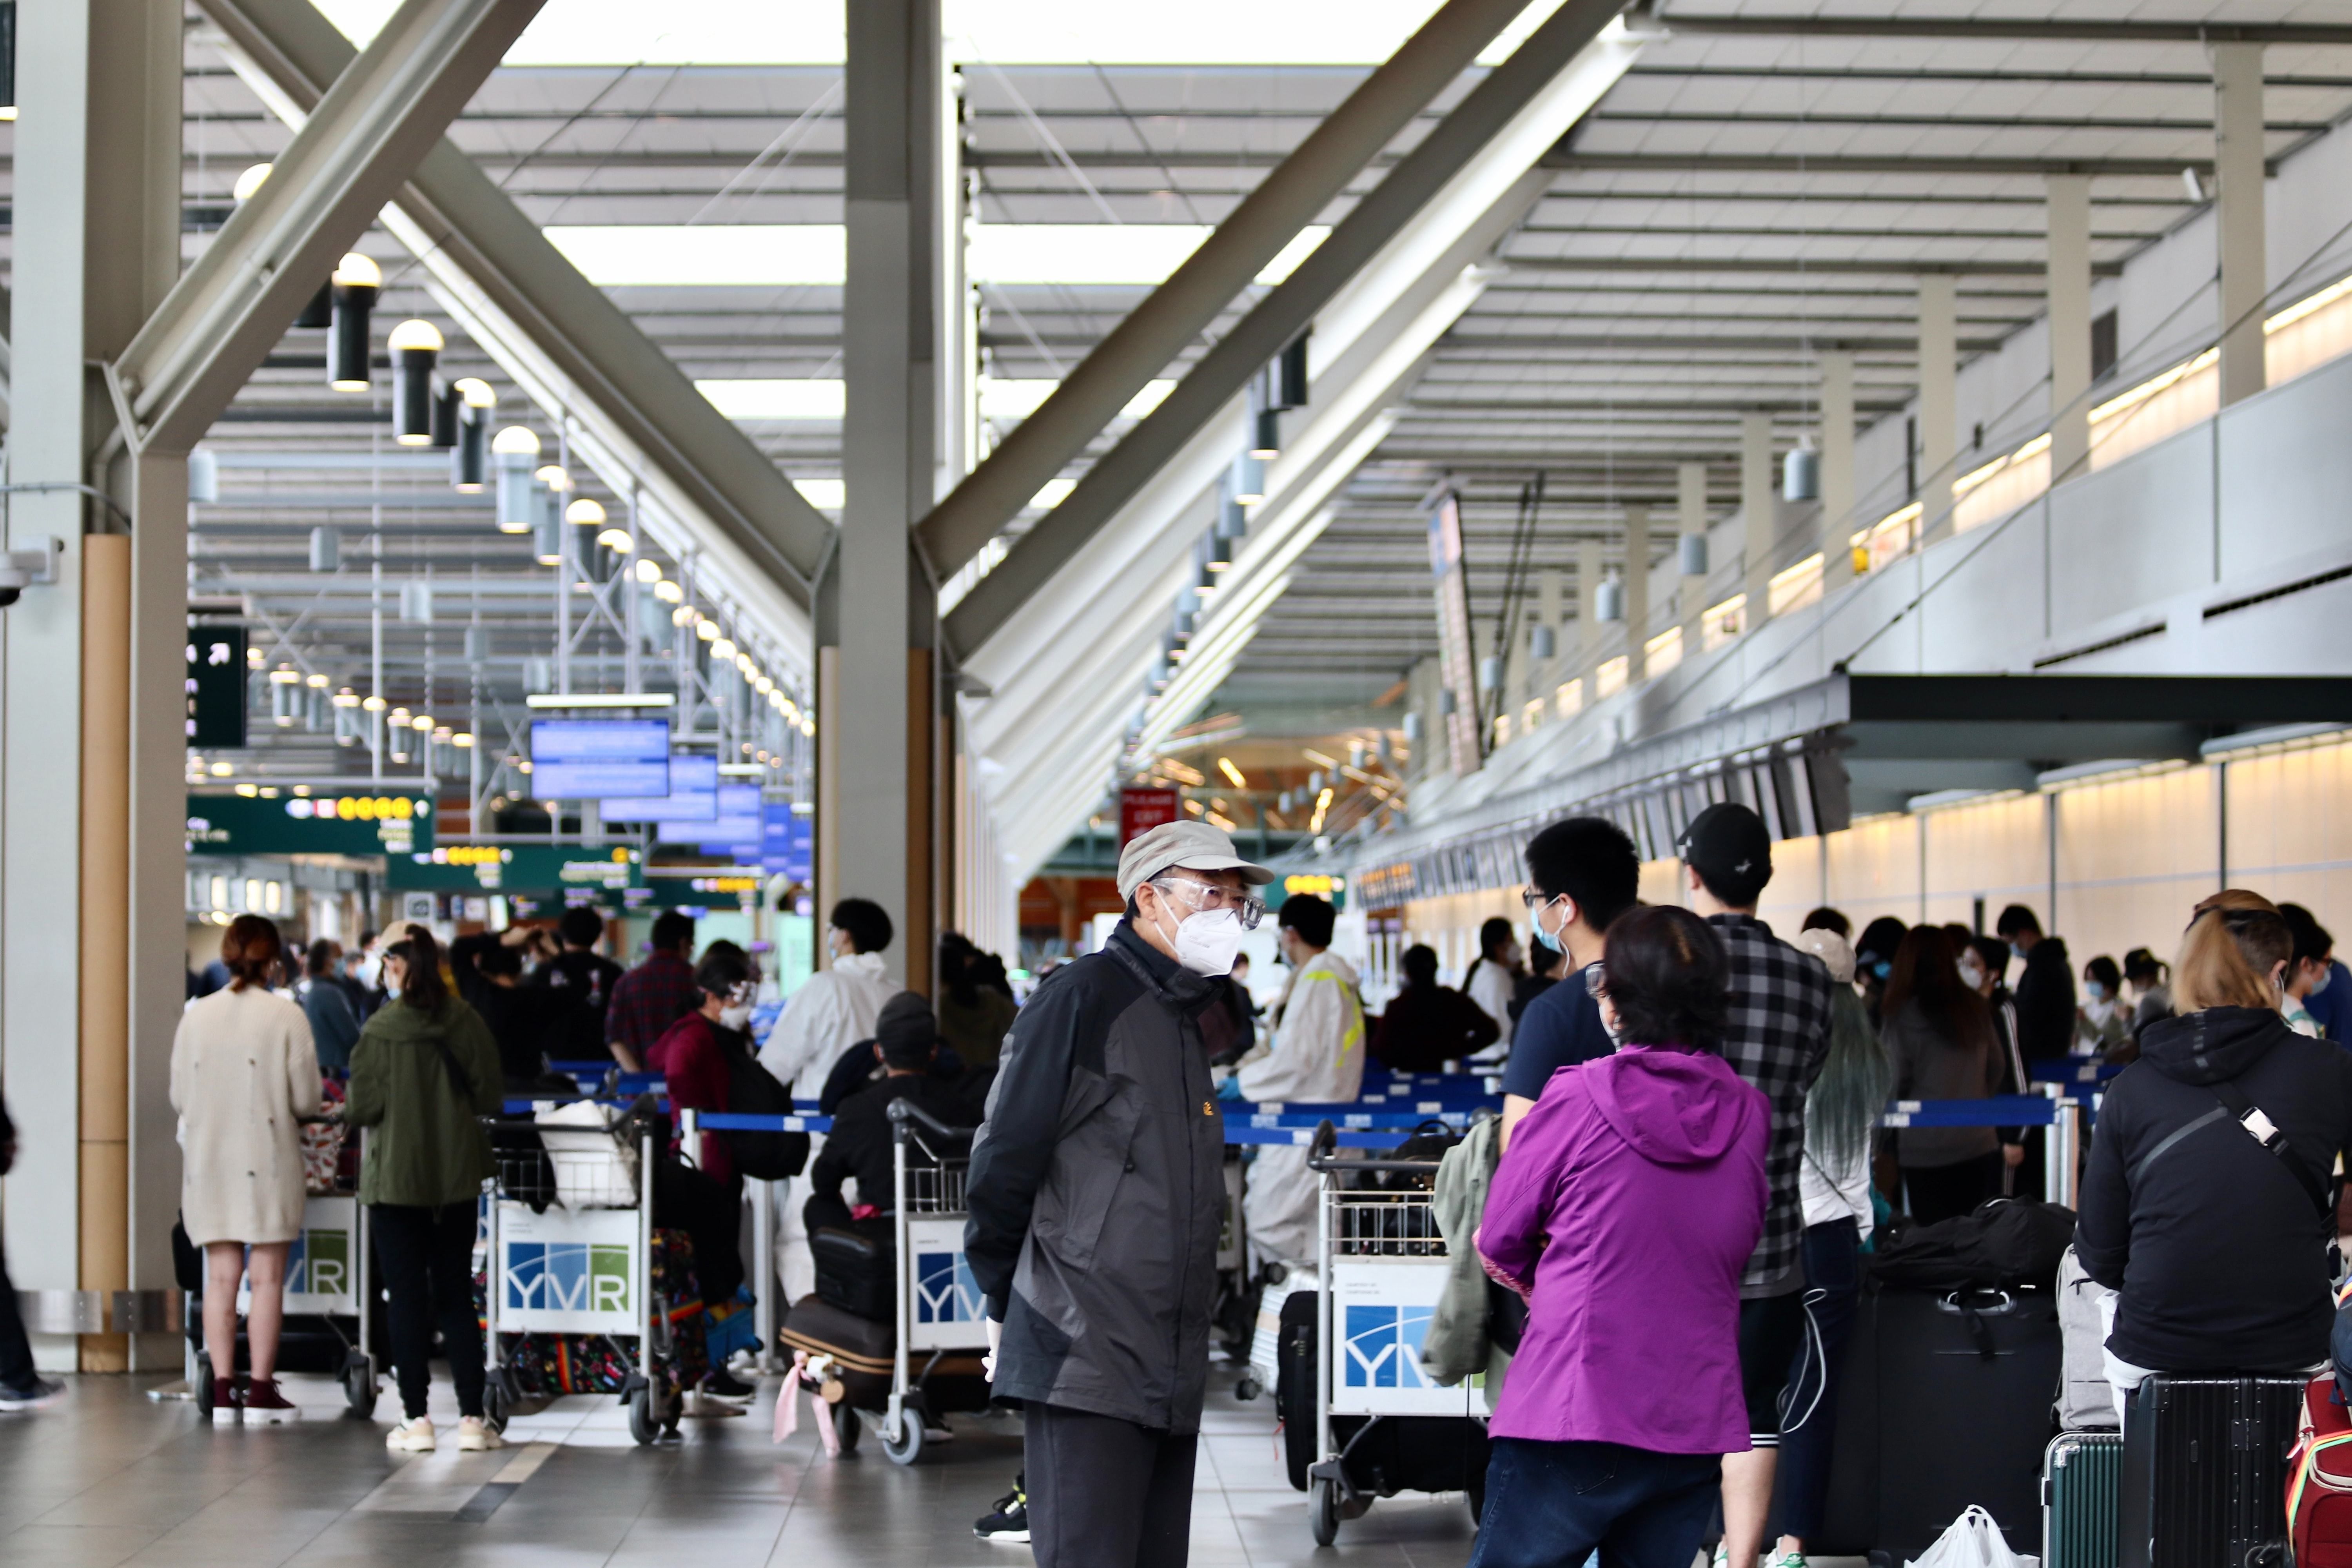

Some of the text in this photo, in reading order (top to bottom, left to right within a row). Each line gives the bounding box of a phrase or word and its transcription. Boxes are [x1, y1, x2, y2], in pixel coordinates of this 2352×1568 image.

[507, 1272, 628, 1311] YVR
[917, 1283, 987, 1323] YV
[1345, 1341, 1436, 1387] YV
